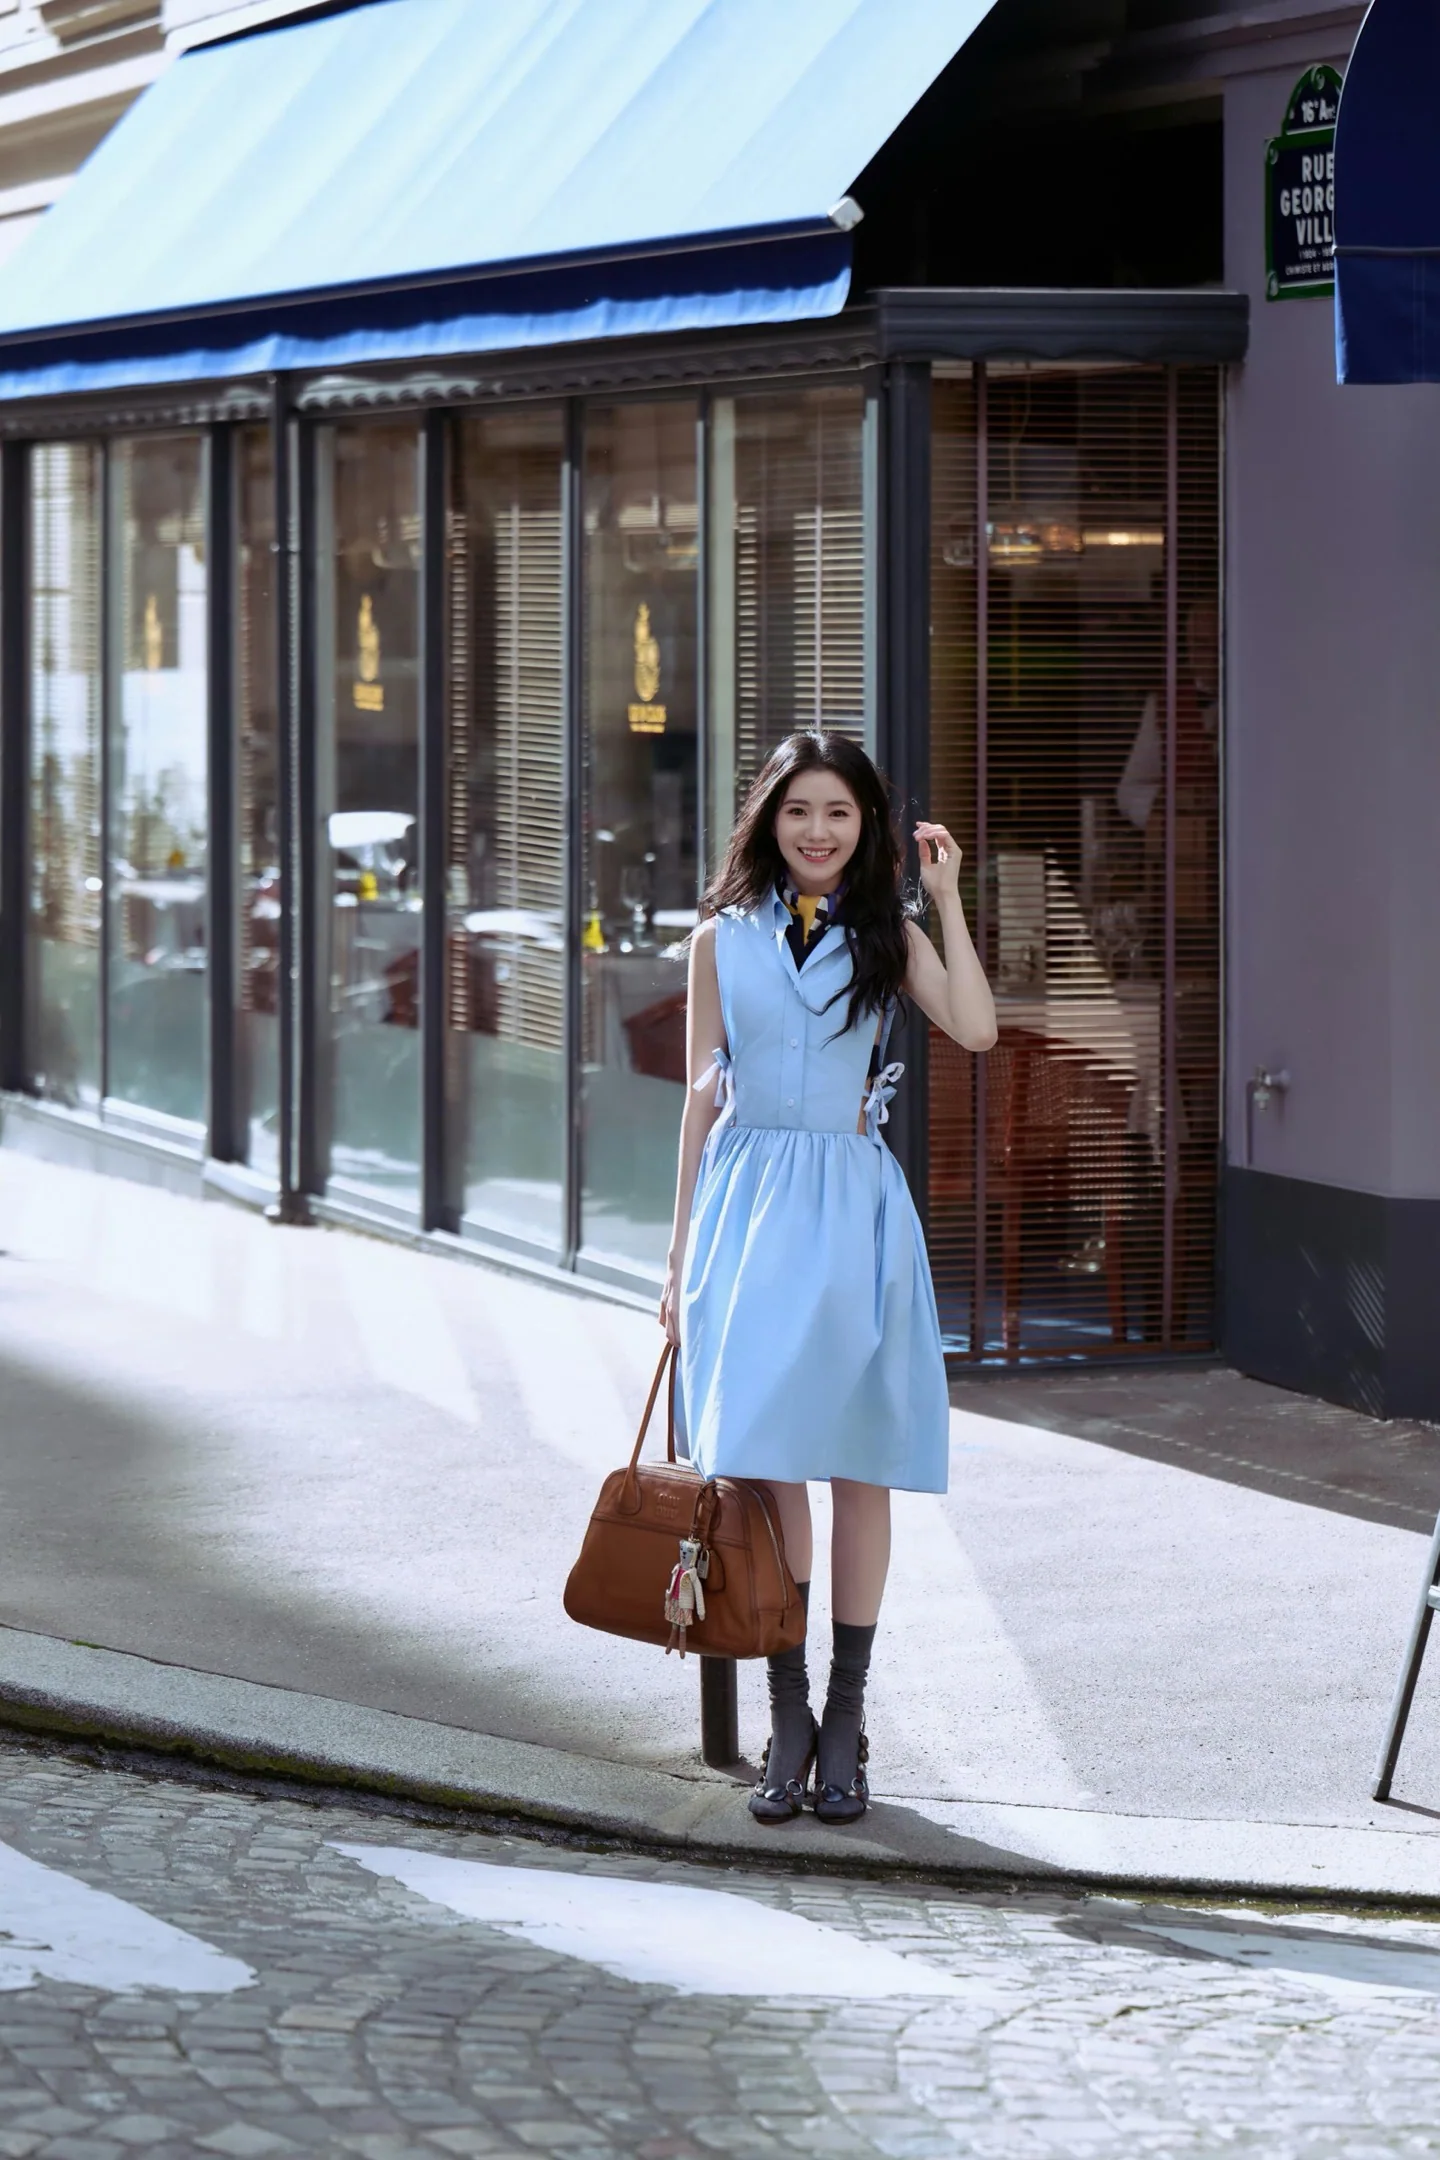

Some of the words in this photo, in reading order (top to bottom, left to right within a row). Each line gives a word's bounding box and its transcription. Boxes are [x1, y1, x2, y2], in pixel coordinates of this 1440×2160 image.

[1302, 152, 1334, 183] RUE
[1280, 182, 1334, 217] GEORG
[1296, 216, 1333, 246] VILL
